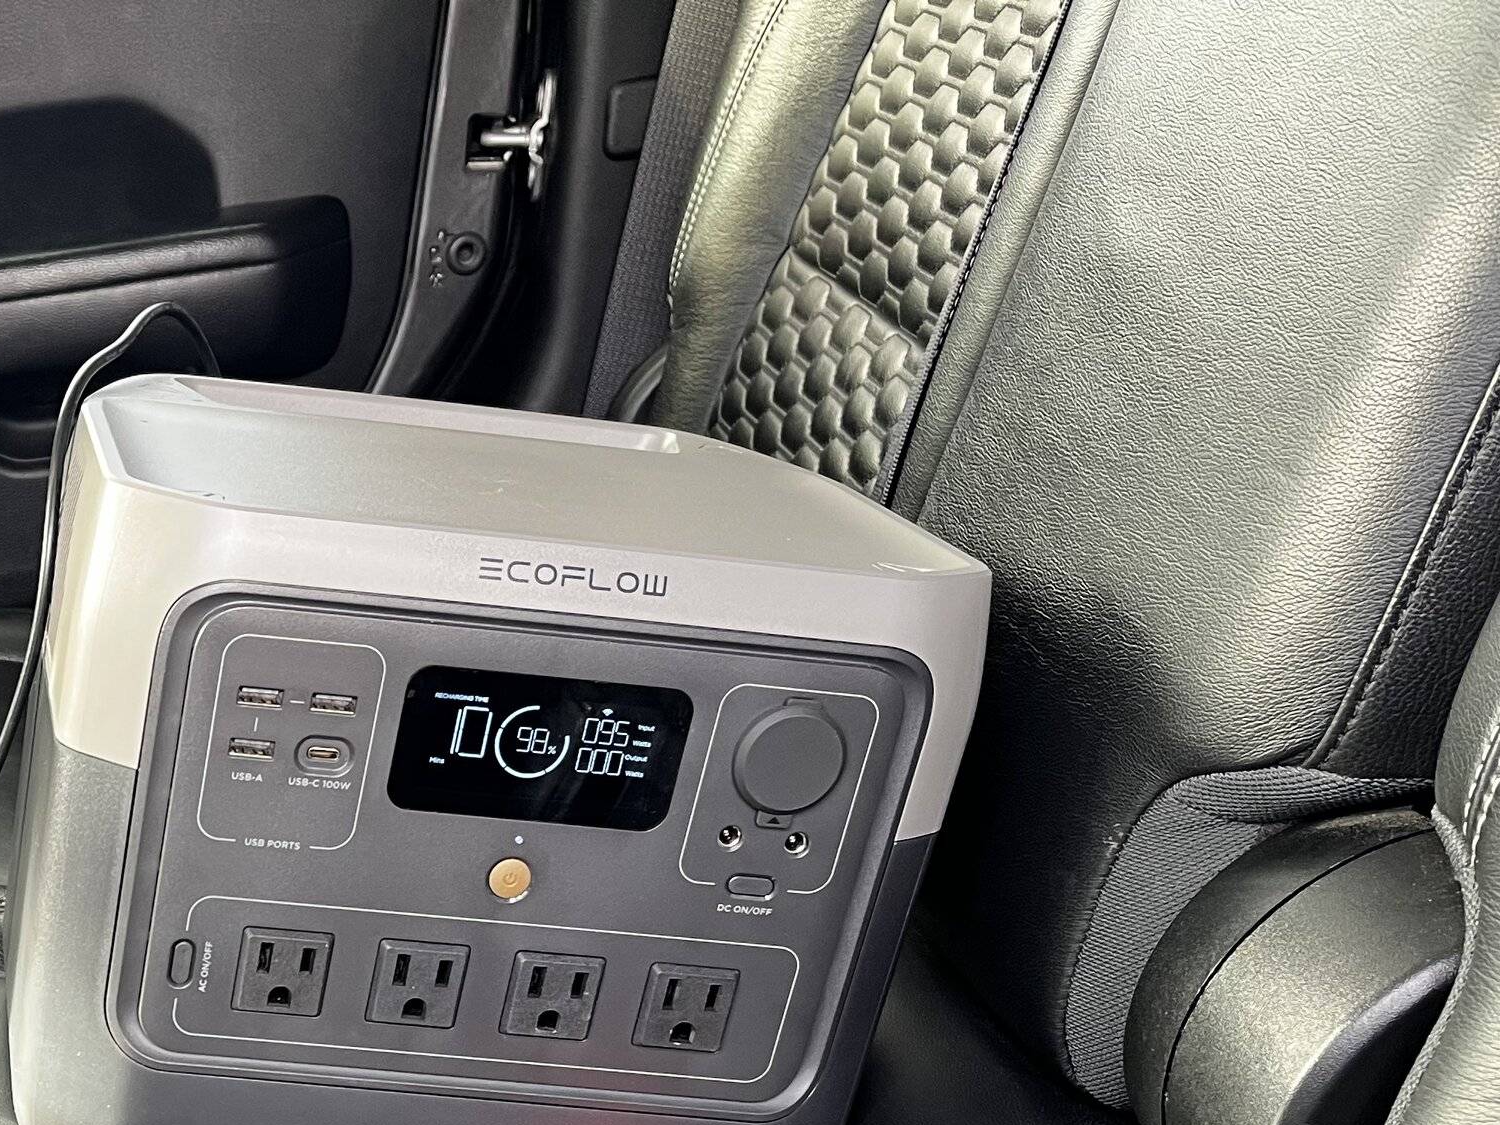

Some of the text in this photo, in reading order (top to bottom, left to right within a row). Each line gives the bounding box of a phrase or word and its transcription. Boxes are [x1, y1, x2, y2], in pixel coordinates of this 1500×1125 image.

[478, 557, 668, 597] ECOFLOW
[450, 705, 493, 758] 10
[581, 717, 630, 747] 095
[231, 771, 263, 782] USB-A
[574, 747, 624, 777] 000
[288, 776, 352, 790] USB-C 100W
[244, 838, 301, 850] USB PORTS
[716, 903, 773, 916] DC ON/OFF
[197, 940, 214, 993] AC ON/OFF
